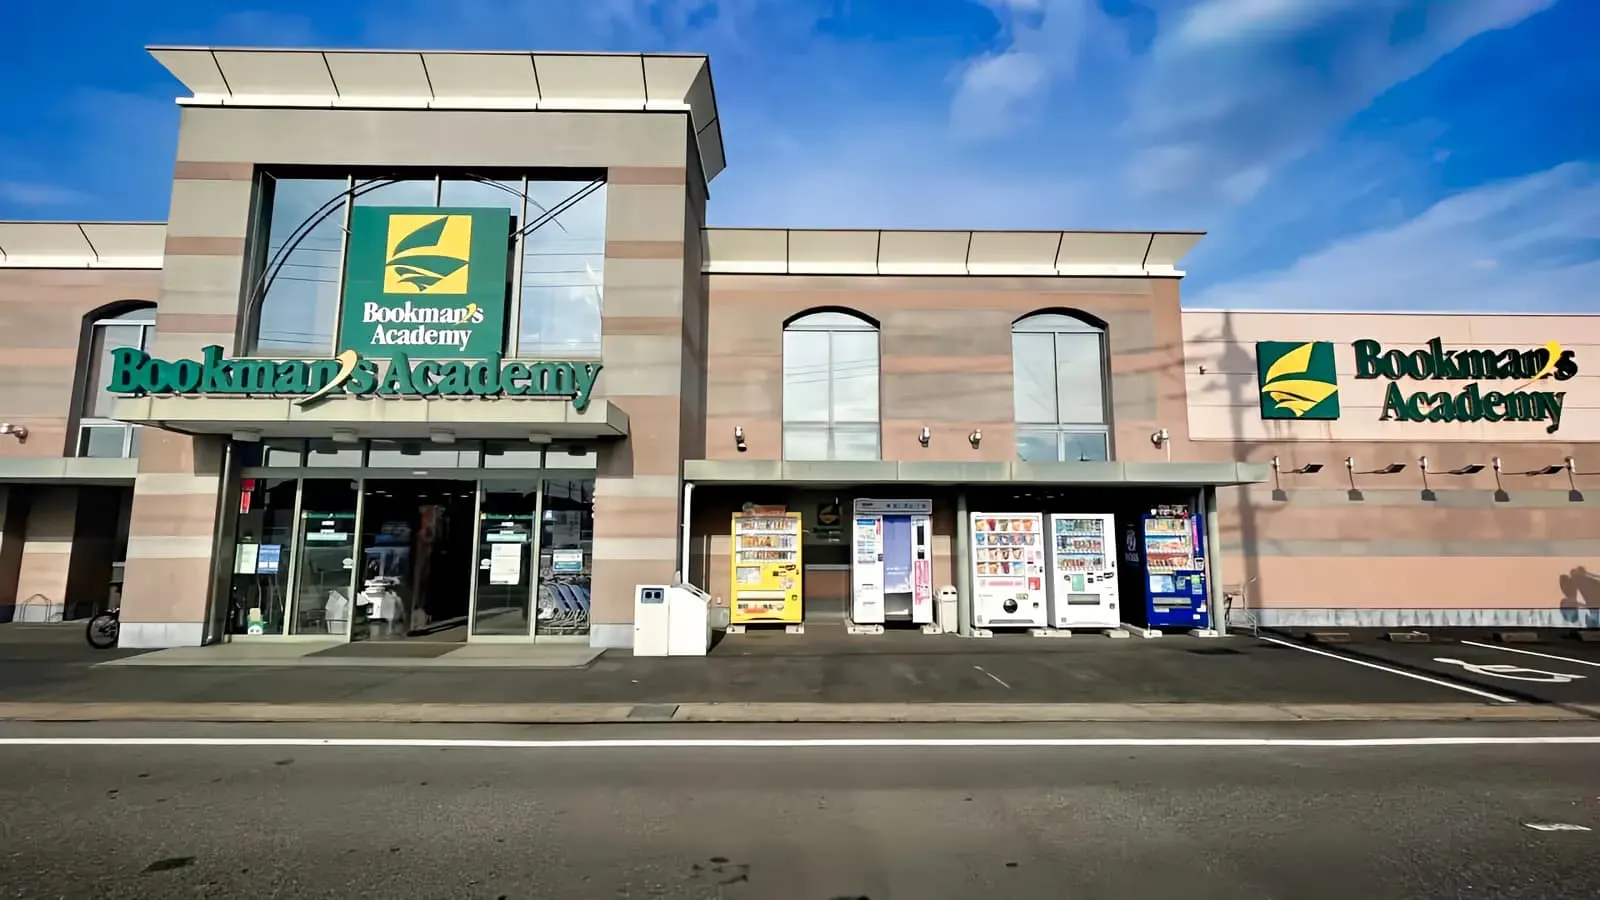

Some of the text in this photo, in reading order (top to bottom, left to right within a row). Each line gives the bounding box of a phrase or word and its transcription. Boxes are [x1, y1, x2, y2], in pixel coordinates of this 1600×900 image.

[362, 301, 484, 324] Bookman's
[370, 323, 472, 352] Academy
[106, 345, 603, 413] Bookman's Academy
[1351, 337, 1578, 389] Bookman's
[1379, 381, 1567, 434] Academy
